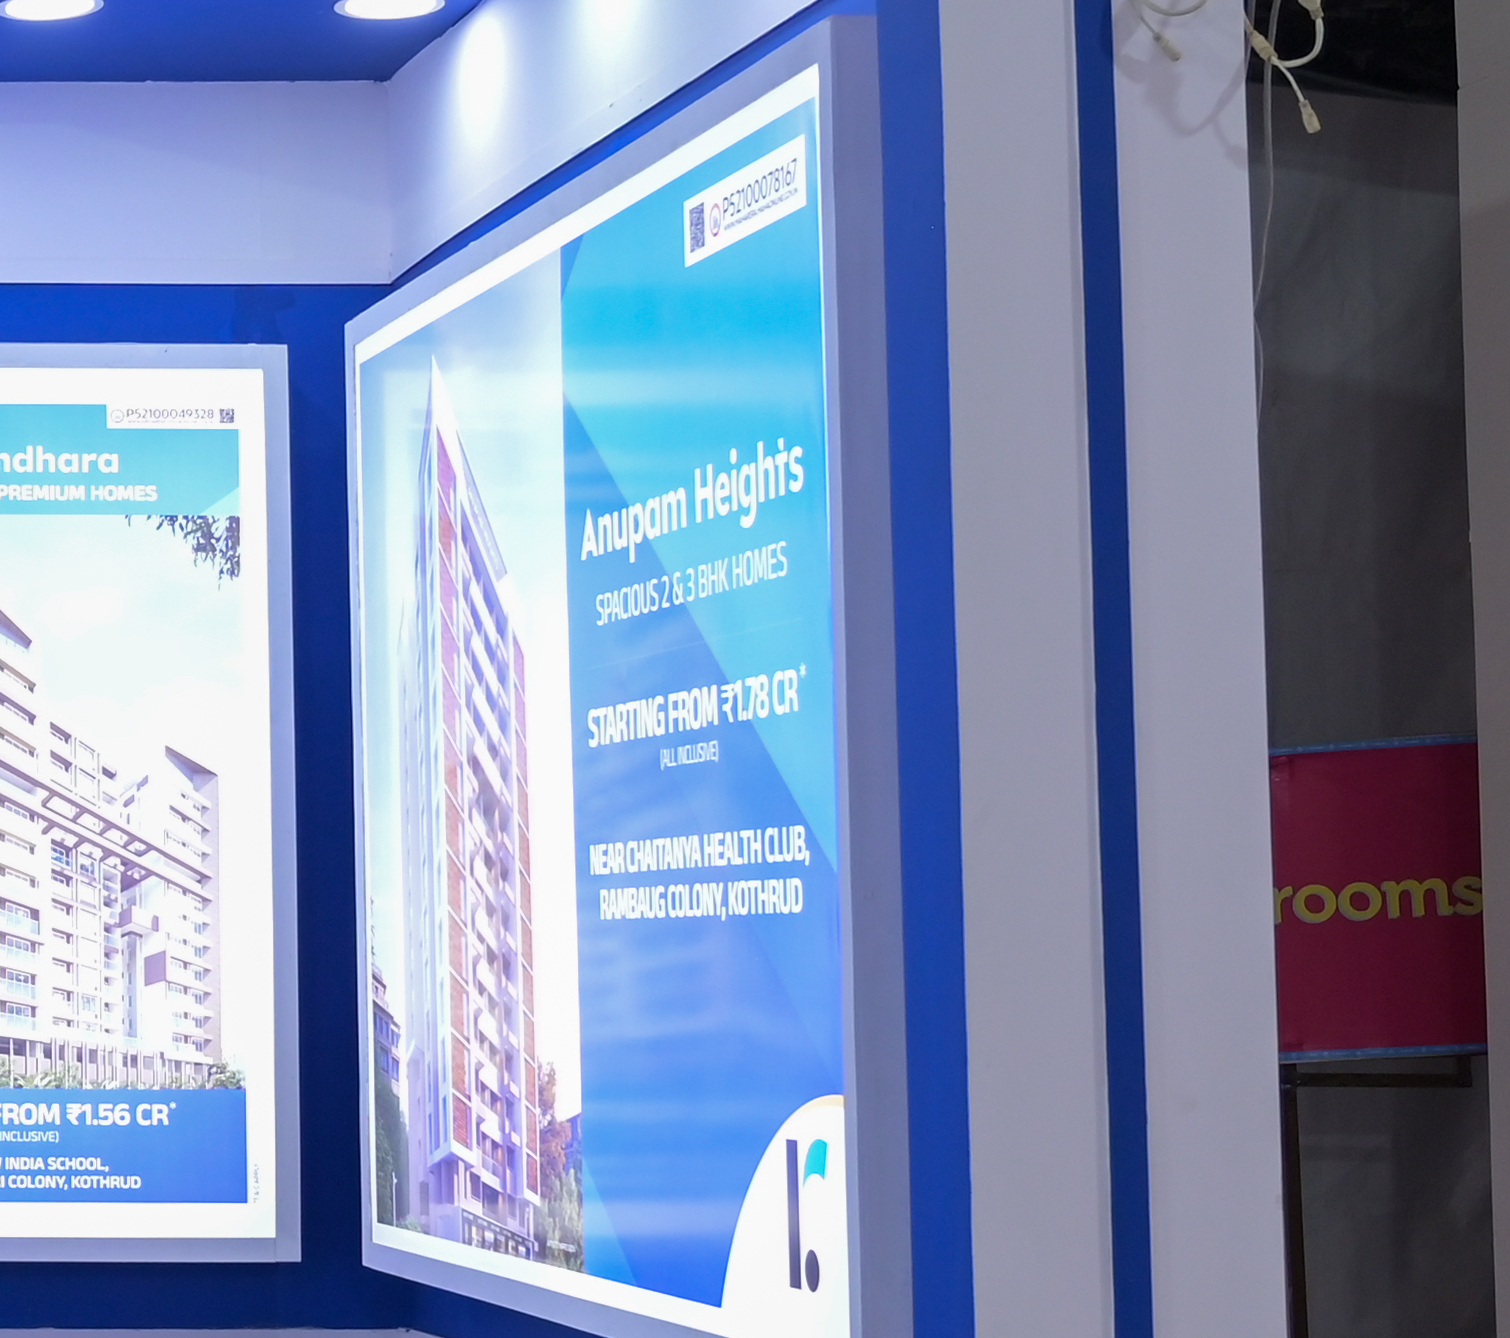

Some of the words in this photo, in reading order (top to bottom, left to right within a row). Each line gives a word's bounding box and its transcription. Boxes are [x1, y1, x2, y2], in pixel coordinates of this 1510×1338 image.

[90, 484, 158, 502] HOMES
[580, 487, 688, 564] Anupam
[694, 437, 805, 529] Heights
[595, 578, 660, 627] SPACIOUS
[661, 575, 671, 609] 2
[672, 571, 685, 606] &
[685, 567, 695, 602] 3
[698, 557, 730, 599] BHK
[731, 540, 788, 590] HOMES
[587, 695, 666, 748] STARTING
[667, 684, 719, 734] FROM
[589, 841, 625, 876] NEAR
[626, 834, 702, 873] CHAITANYA
[703, 829, 762, 868] HEALTH
[764, 825, 811, 866] CLUB,
[599, 885, 666, 921] RAMBAUG
[667, 881, 727, 922] COLONY,
[728, 877, 804, 916] KOTHRUD
[65, 1102, 131, 1126] ₹1.56
[0, 1130, 60, 1144] INCLUSIVE)
[4, 1157, 45, 1170] INDIA
[47, 1157, 109, 1172] SCHOOL,
[8, 1175, 68, 1190] COLONY,
[71, 1175, 142, 1189] KOTHRUD
